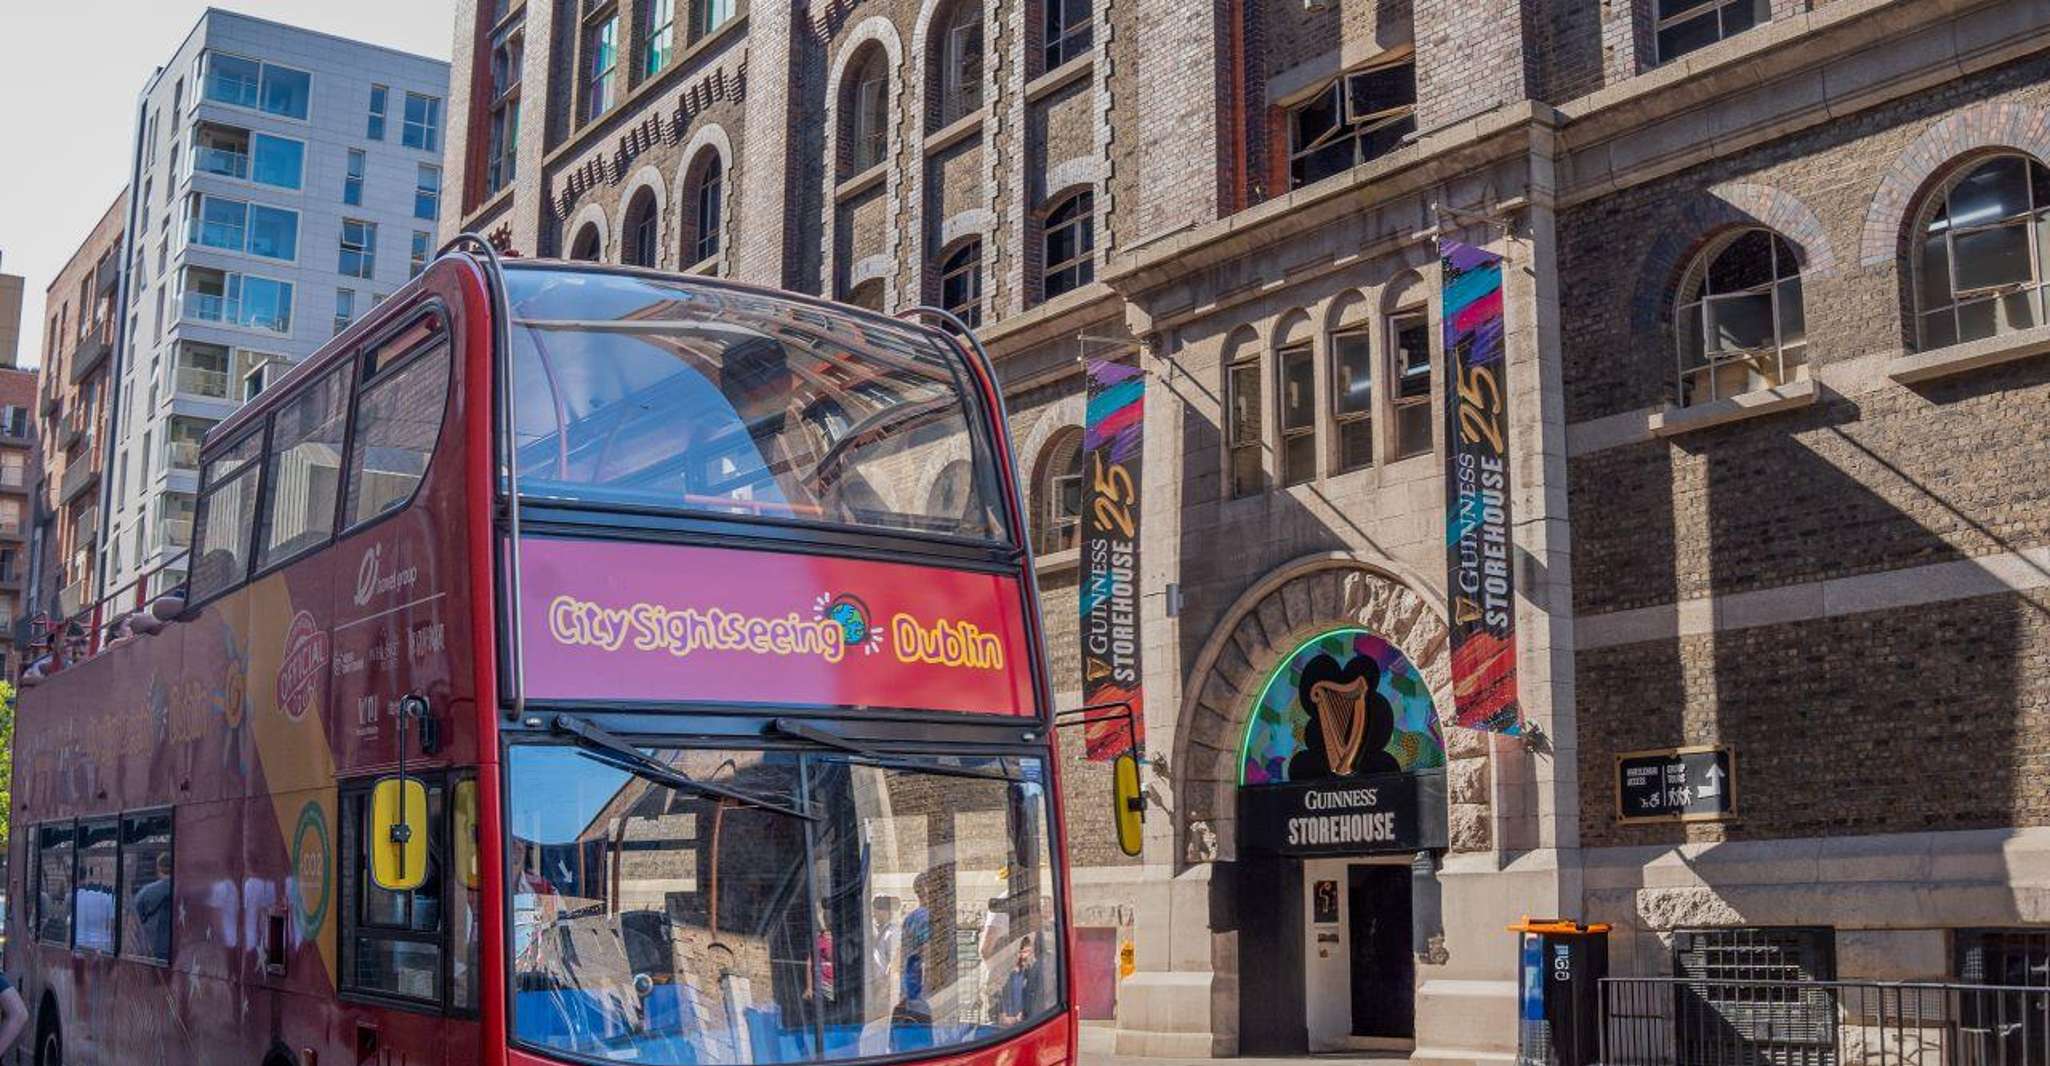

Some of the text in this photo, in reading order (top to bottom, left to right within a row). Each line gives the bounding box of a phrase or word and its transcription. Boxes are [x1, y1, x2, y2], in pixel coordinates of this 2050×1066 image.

[1458, 452, 1481, 594] GUINNESS
[1482, 455, 1509, 627] STOREHOUSE
[892, 613, 1004, 669] Dublin
[1087, 539, 1108, 655] GUINNESS
[1111, 541, 1135, 681] STOREHOUSE
[1289, 812, 1395, 845] STOREHOUSE
[1305, 789, 1377, 809] GUINNESS
